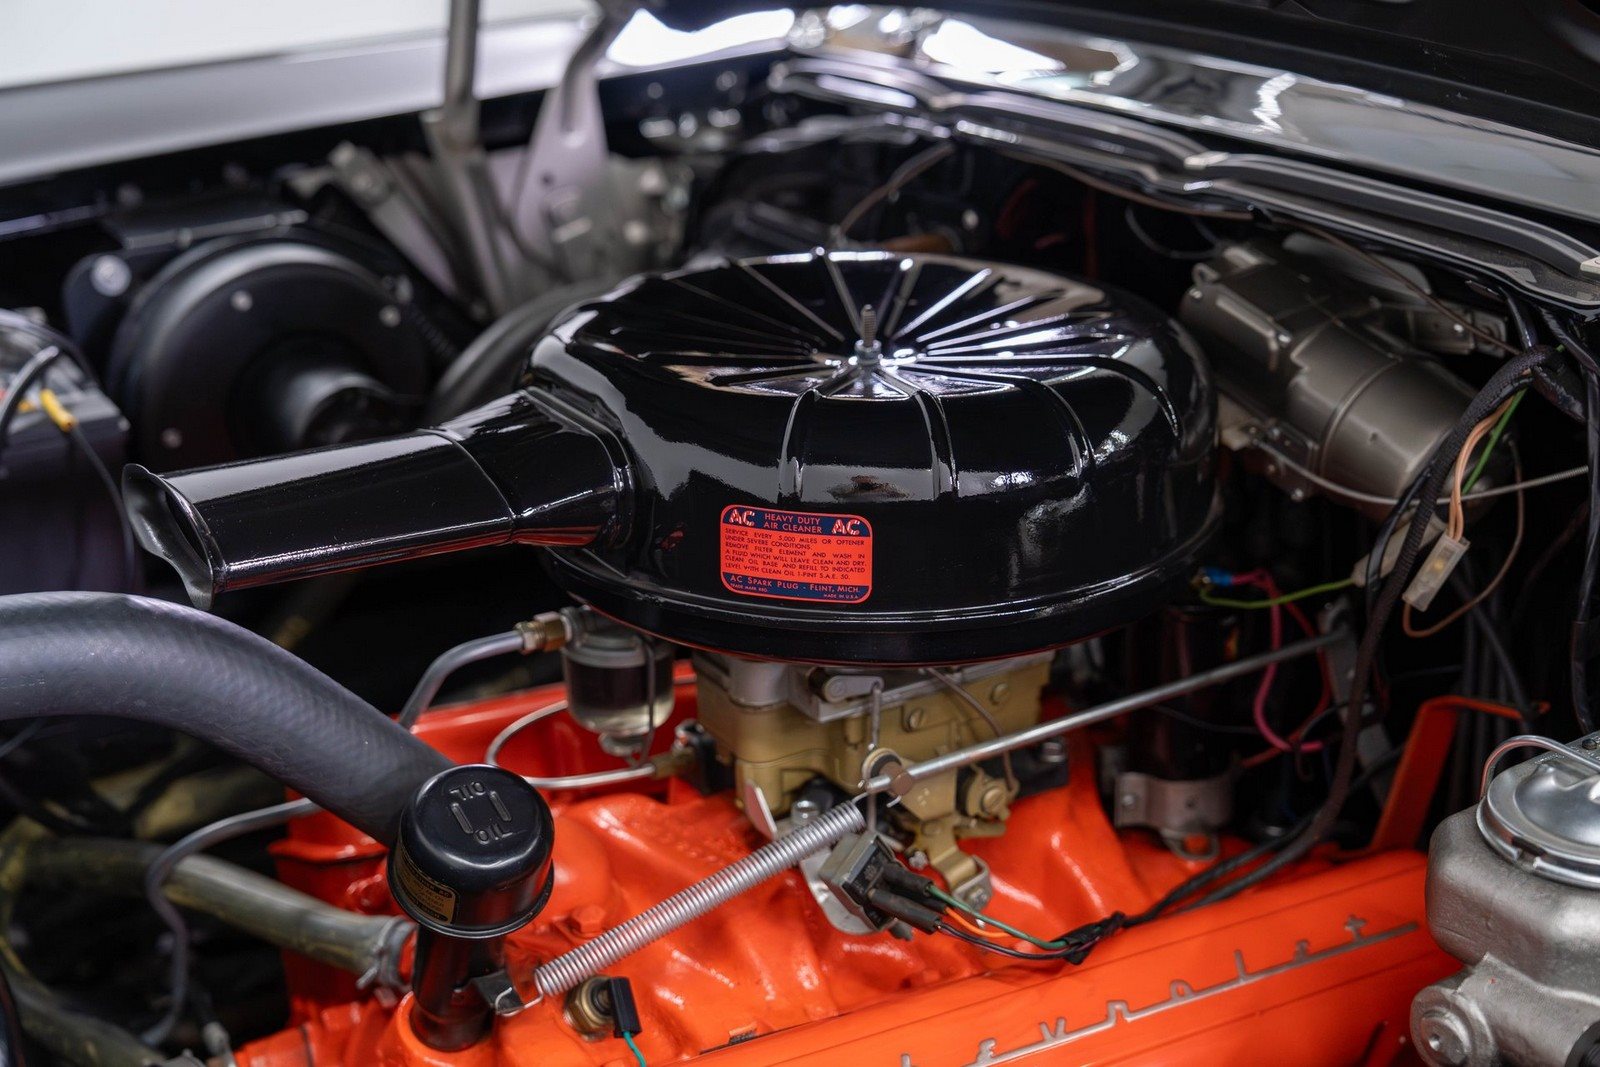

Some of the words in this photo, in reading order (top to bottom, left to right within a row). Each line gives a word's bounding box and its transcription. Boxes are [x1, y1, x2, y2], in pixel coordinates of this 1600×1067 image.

[729, 509, 755, 526] AC
[765, 513, 793, 523] HEAVY
[797, 516, 820, 525] DUTY
[782, 523, 822, 533] CLEANER
[832, 519, 860, 535] AC
[725, 528, 748, 536] SERVICE
[754, 532, 772, 540] EVERY
[725, 534, 745, 542] UNDER
[747, 538, 768, 546] SEVERE
[725, 541, 748, 550] REMOVE
[750, 552, 771, 560] WHICH
[761, 567, 782, 575] CLEAN
[832, 565, 866, 573] INDICATED
[730, 575, 743, 583] AC
[777, 581, 799, 590] PLUG
[450, 782, 486, 801] OIL
[473, 821, 514, 845] OIL
